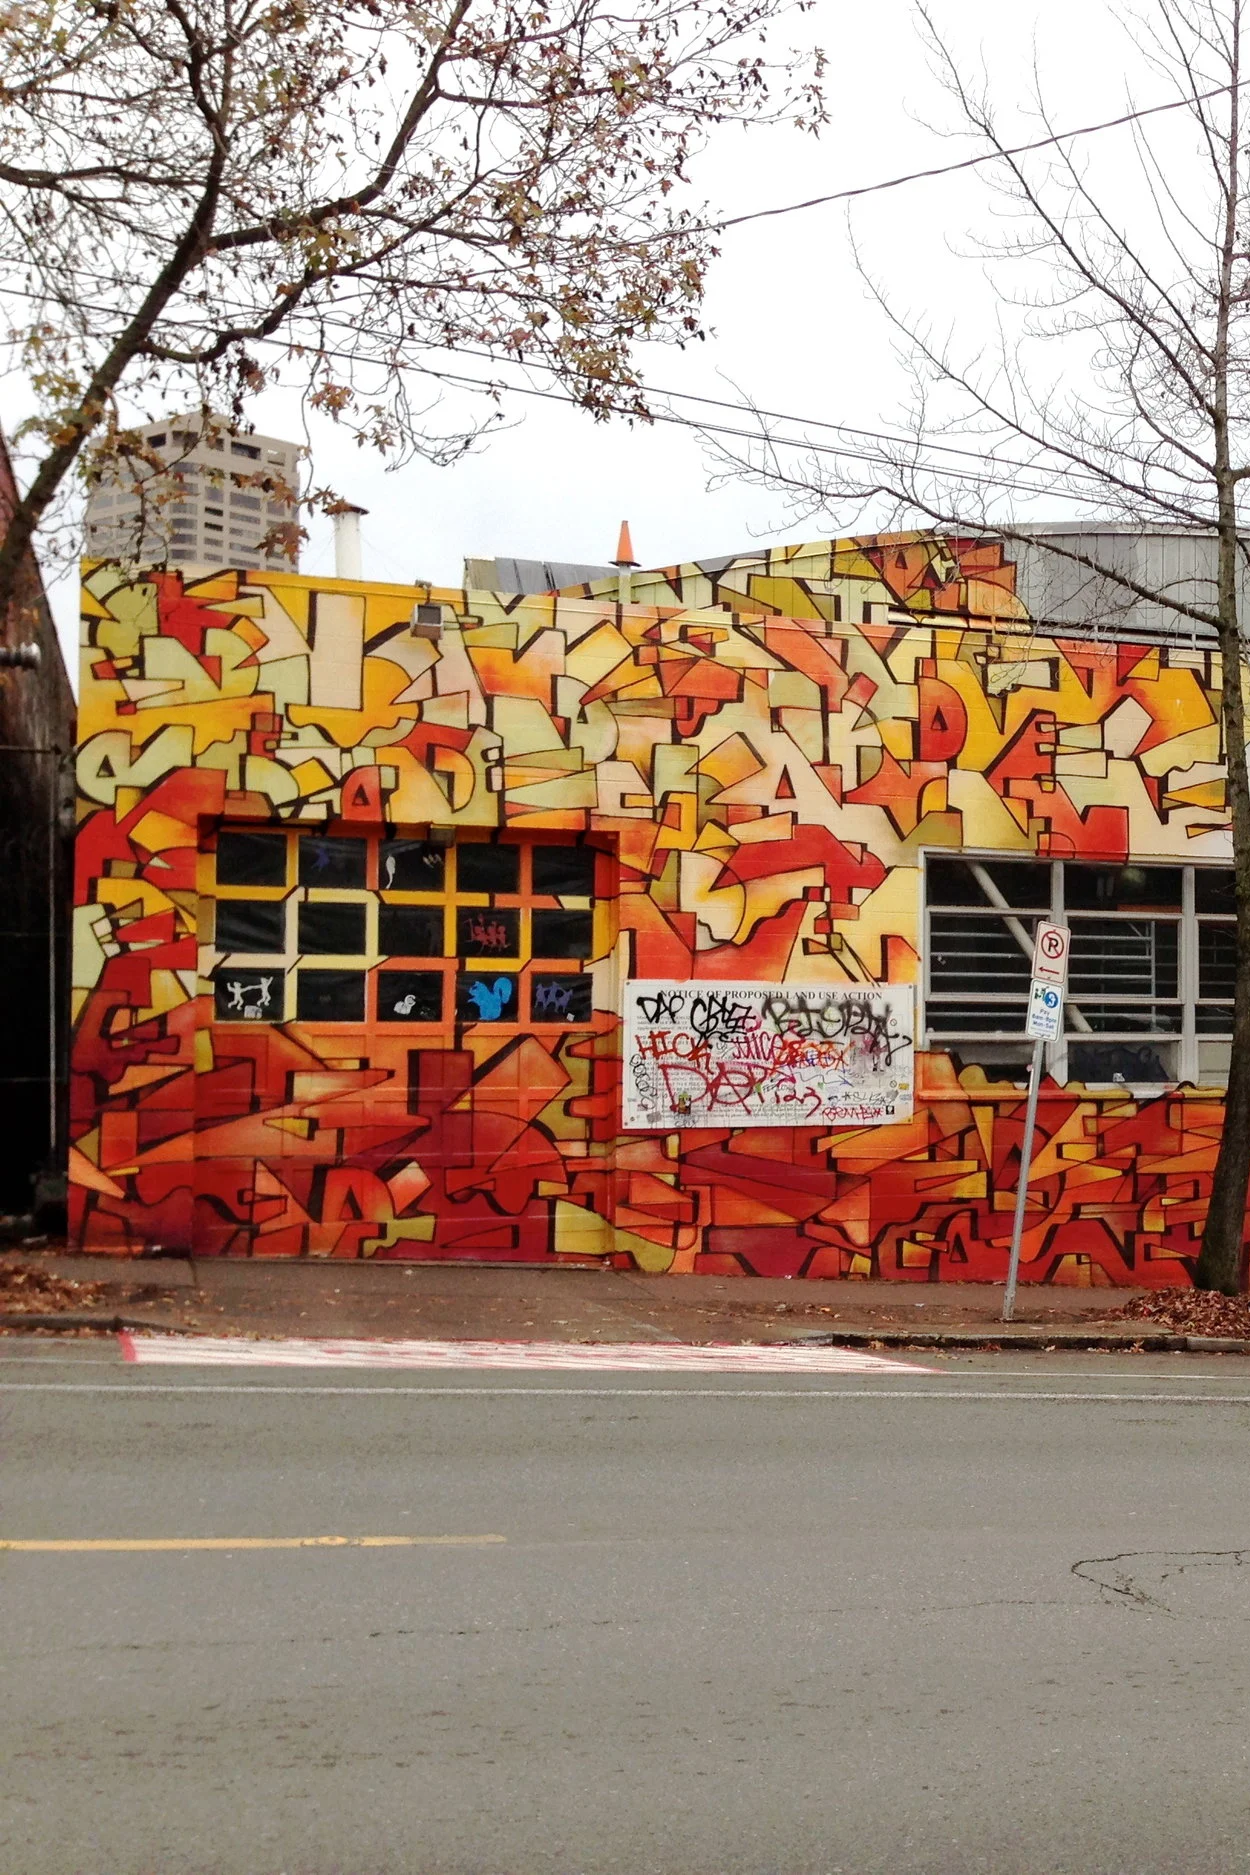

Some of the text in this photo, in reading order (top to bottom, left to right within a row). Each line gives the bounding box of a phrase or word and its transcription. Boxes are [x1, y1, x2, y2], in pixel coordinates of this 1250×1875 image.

[660, 990, 883, 1001] NOTICE OF PROPOSED LAND USE ACTION
